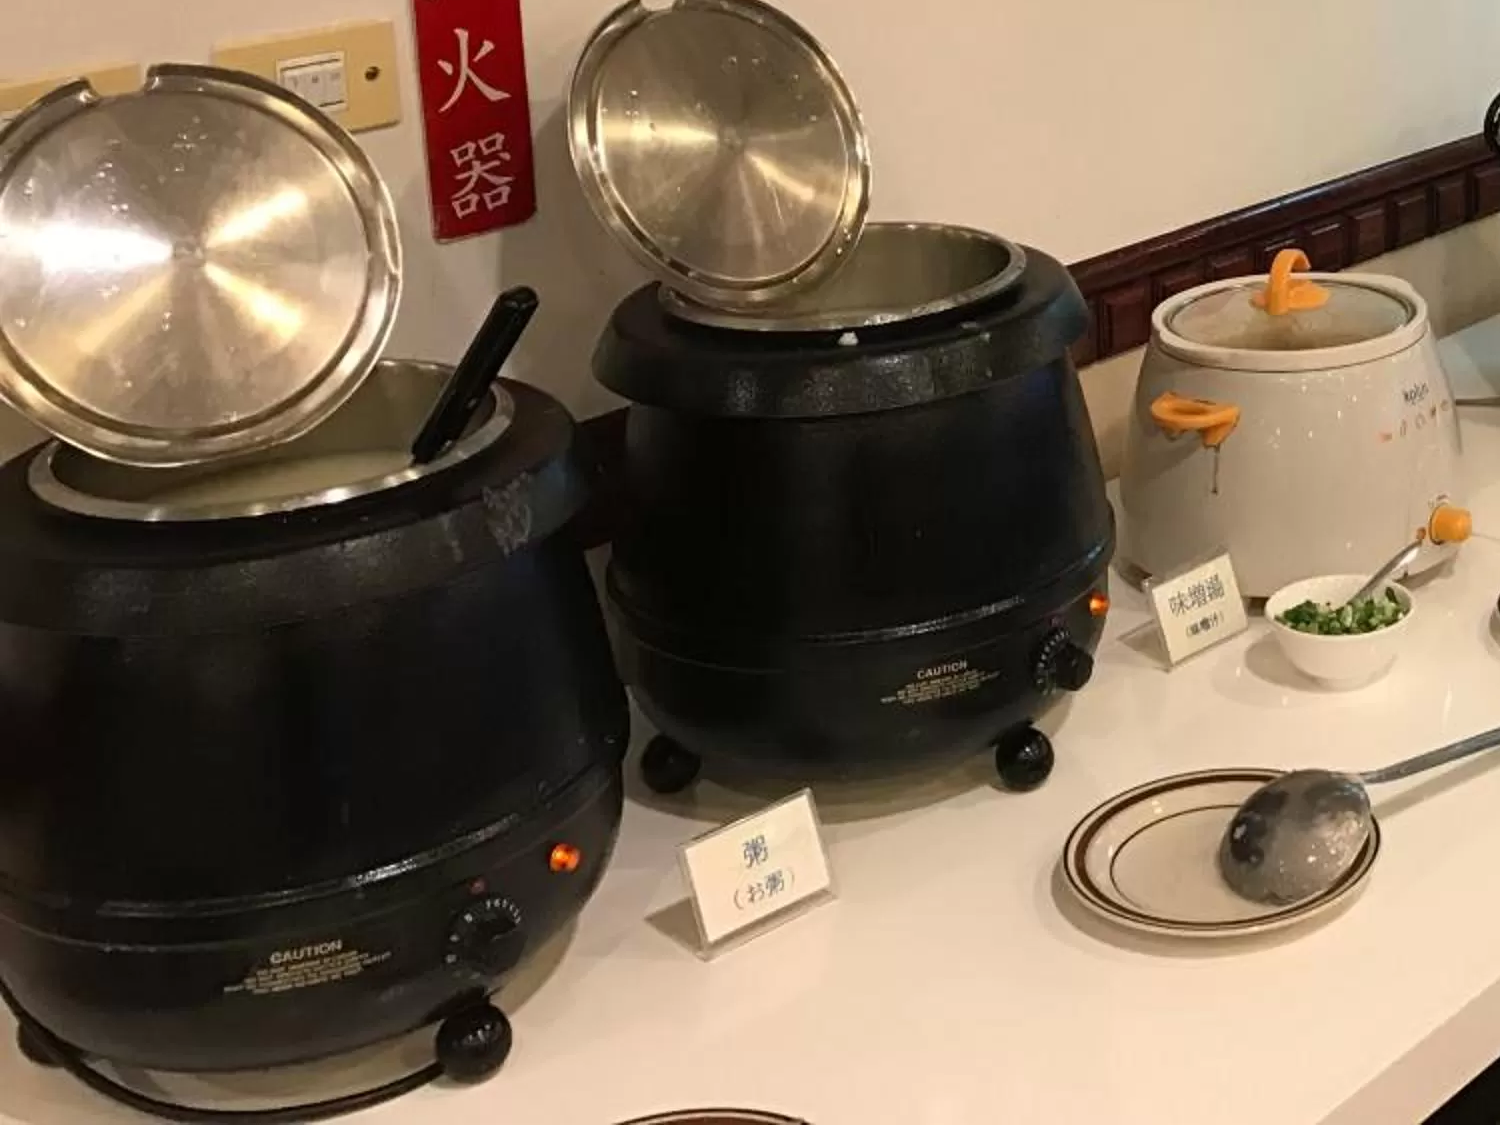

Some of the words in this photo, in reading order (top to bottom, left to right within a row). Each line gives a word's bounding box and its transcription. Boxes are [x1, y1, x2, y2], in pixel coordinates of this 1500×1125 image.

[916, 659, 968, 680] CAUTION
[742, 834, 769, 868] 粥
[269, 938, 343, 965] CAUTION
